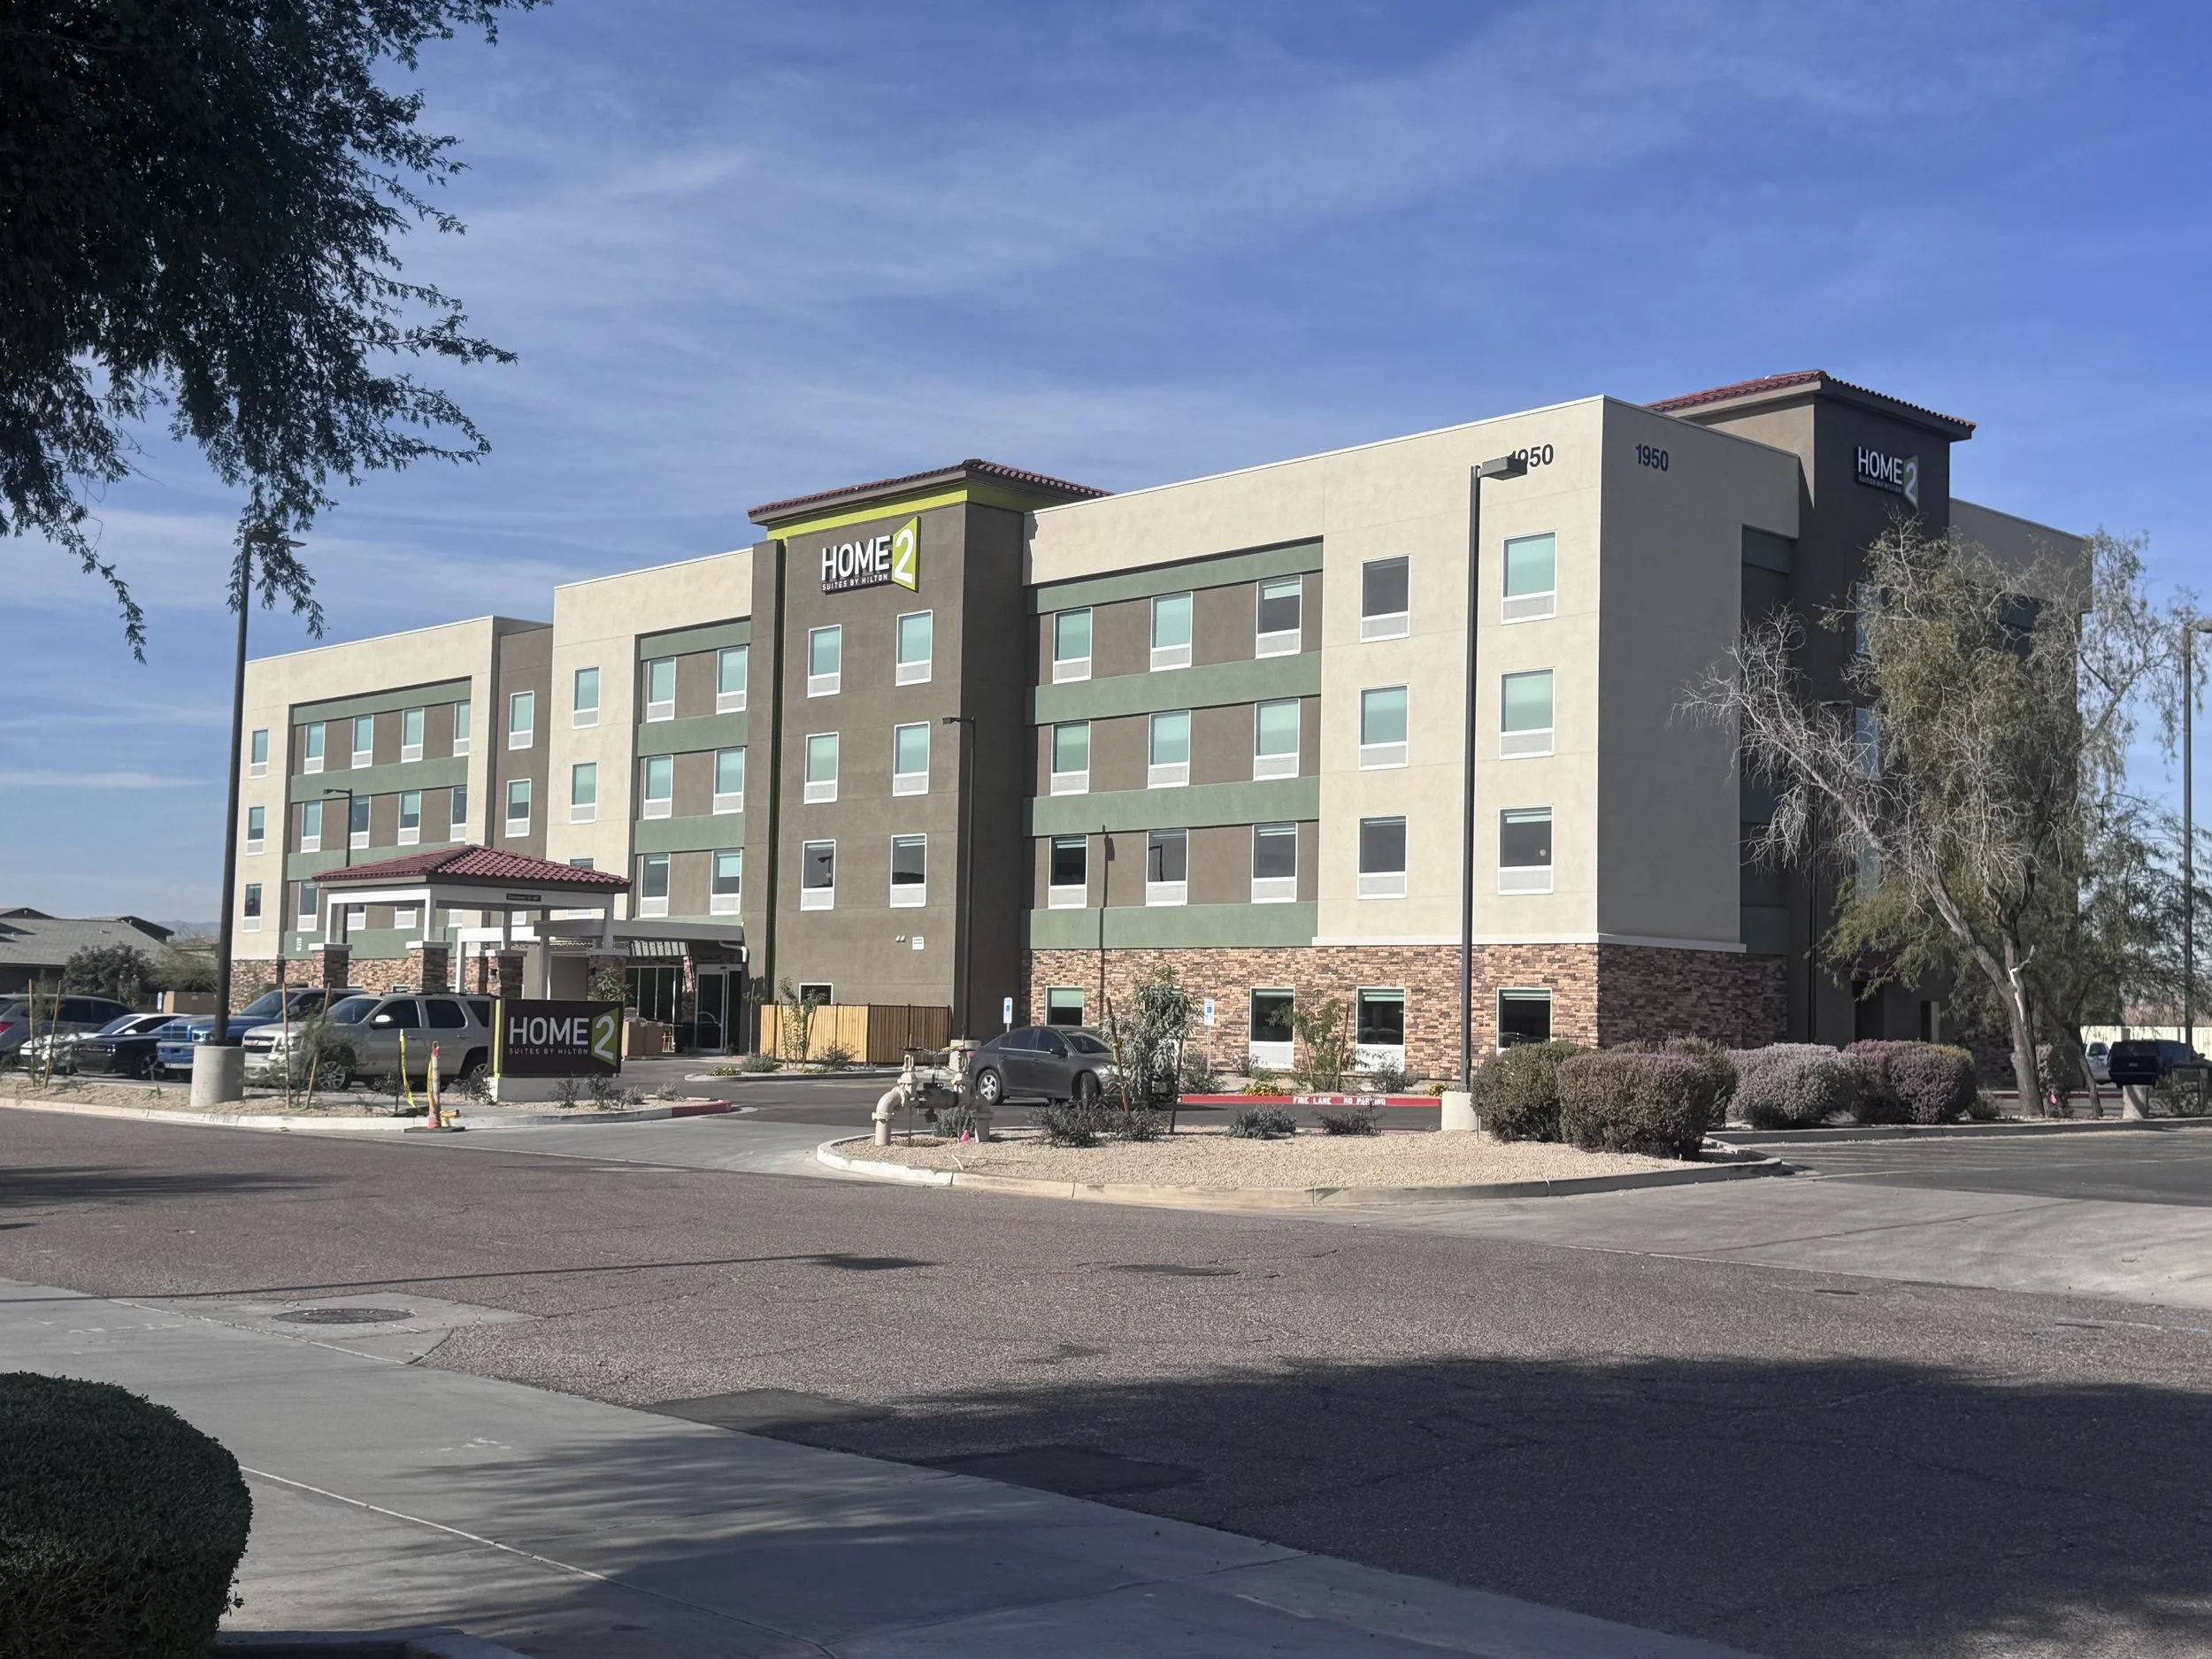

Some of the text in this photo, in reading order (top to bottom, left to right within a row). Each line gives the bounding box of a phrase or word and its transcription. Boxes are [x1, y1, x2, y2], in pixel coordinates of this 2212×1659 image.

[1635, 443, 1670, 472] 1950
[822, 573, 888, 591] SUITES BY HILTON
